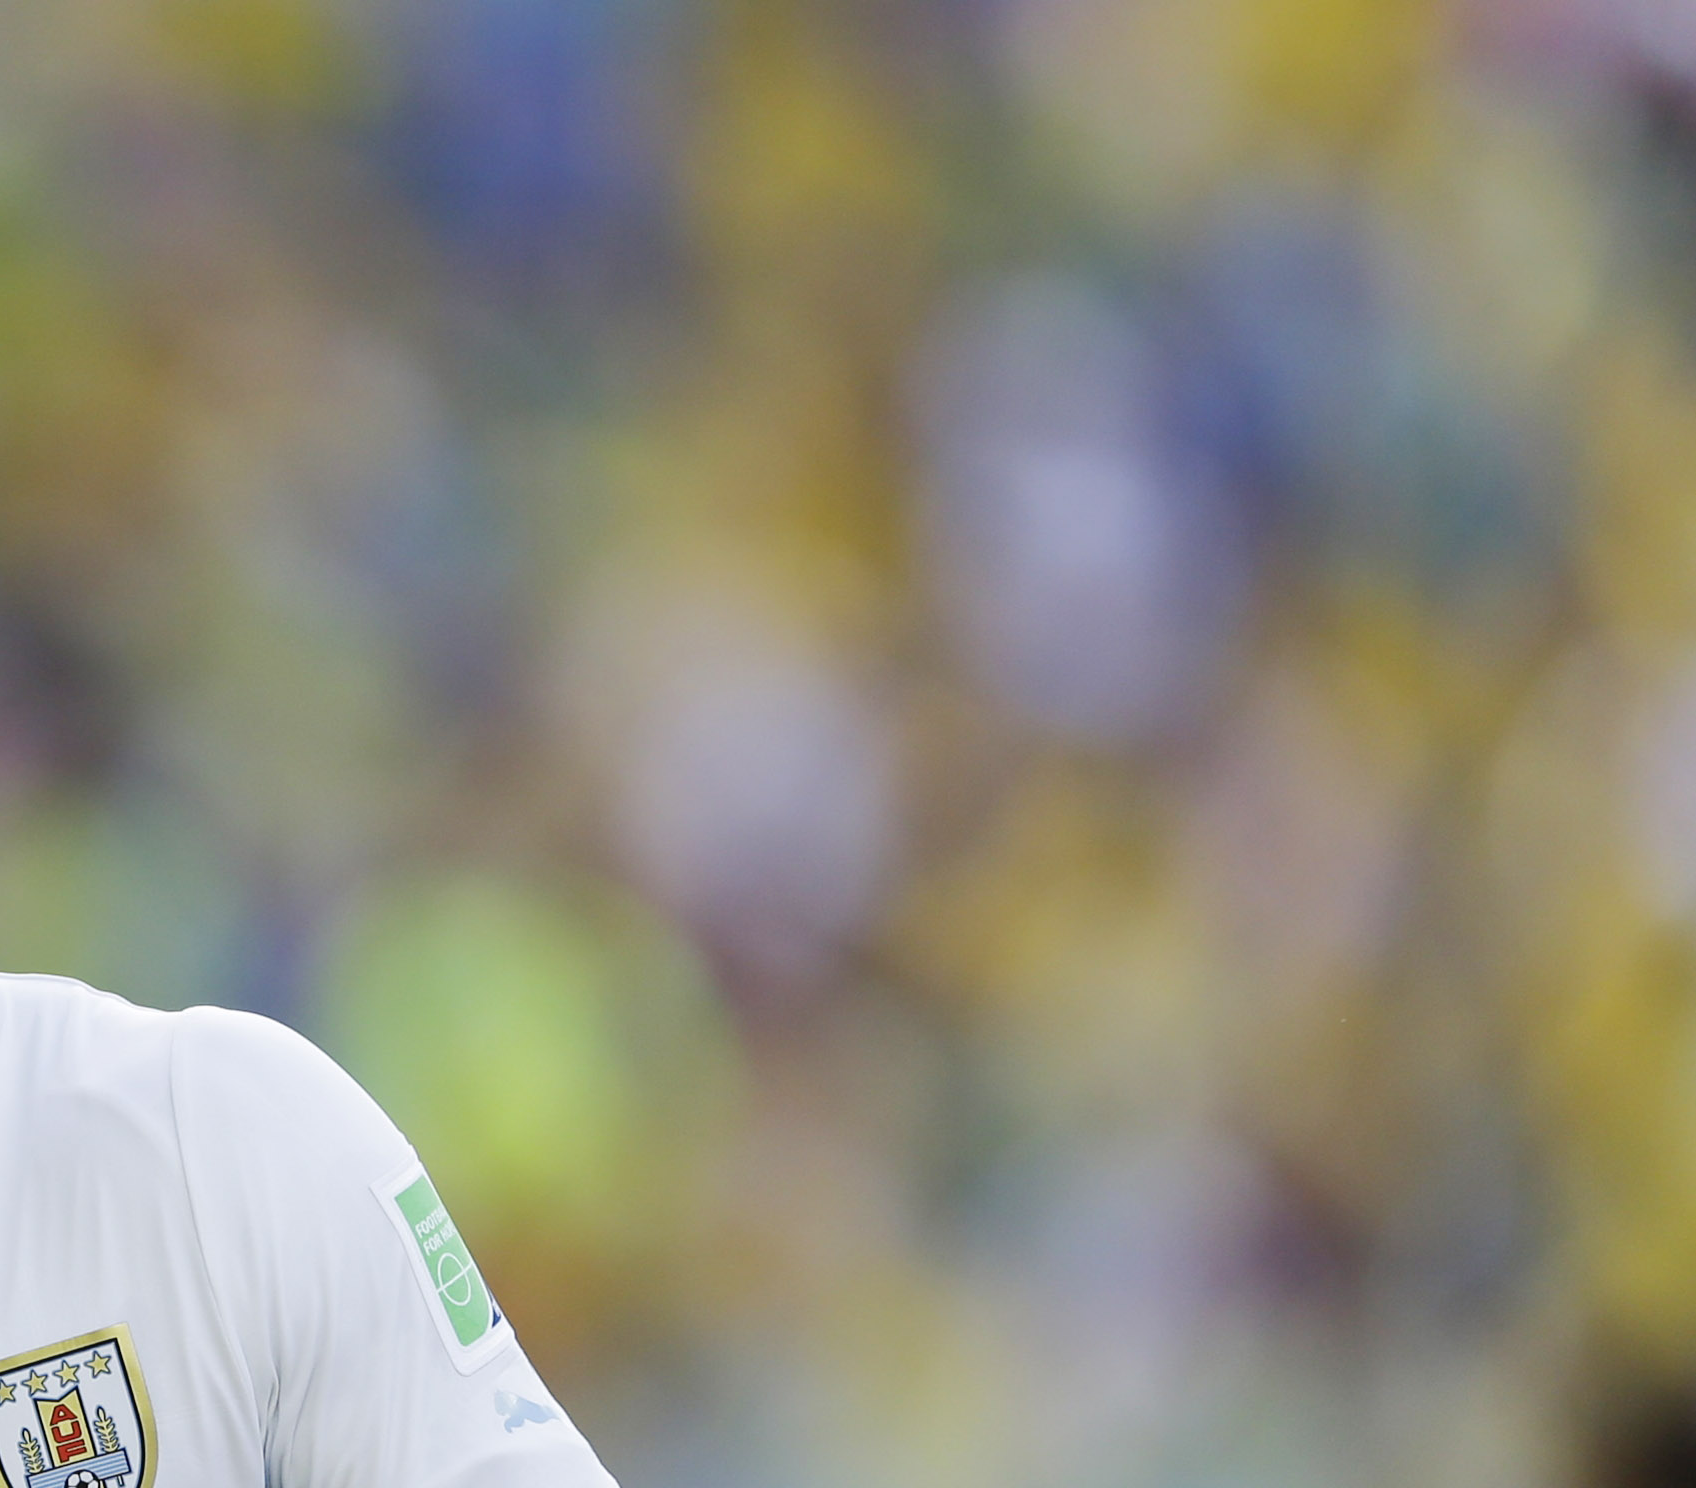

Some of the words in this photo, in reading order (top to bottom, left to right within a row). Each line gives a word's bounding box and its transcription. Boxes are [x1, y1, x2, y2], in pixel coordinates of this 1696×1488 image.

[415, 1206, 448, 1239] FOOTB
[423, 1232, 444, 1256] FOR
[439, 1216, 458, 1242] HOP
[49, 1403, 88, 1464] AUF
